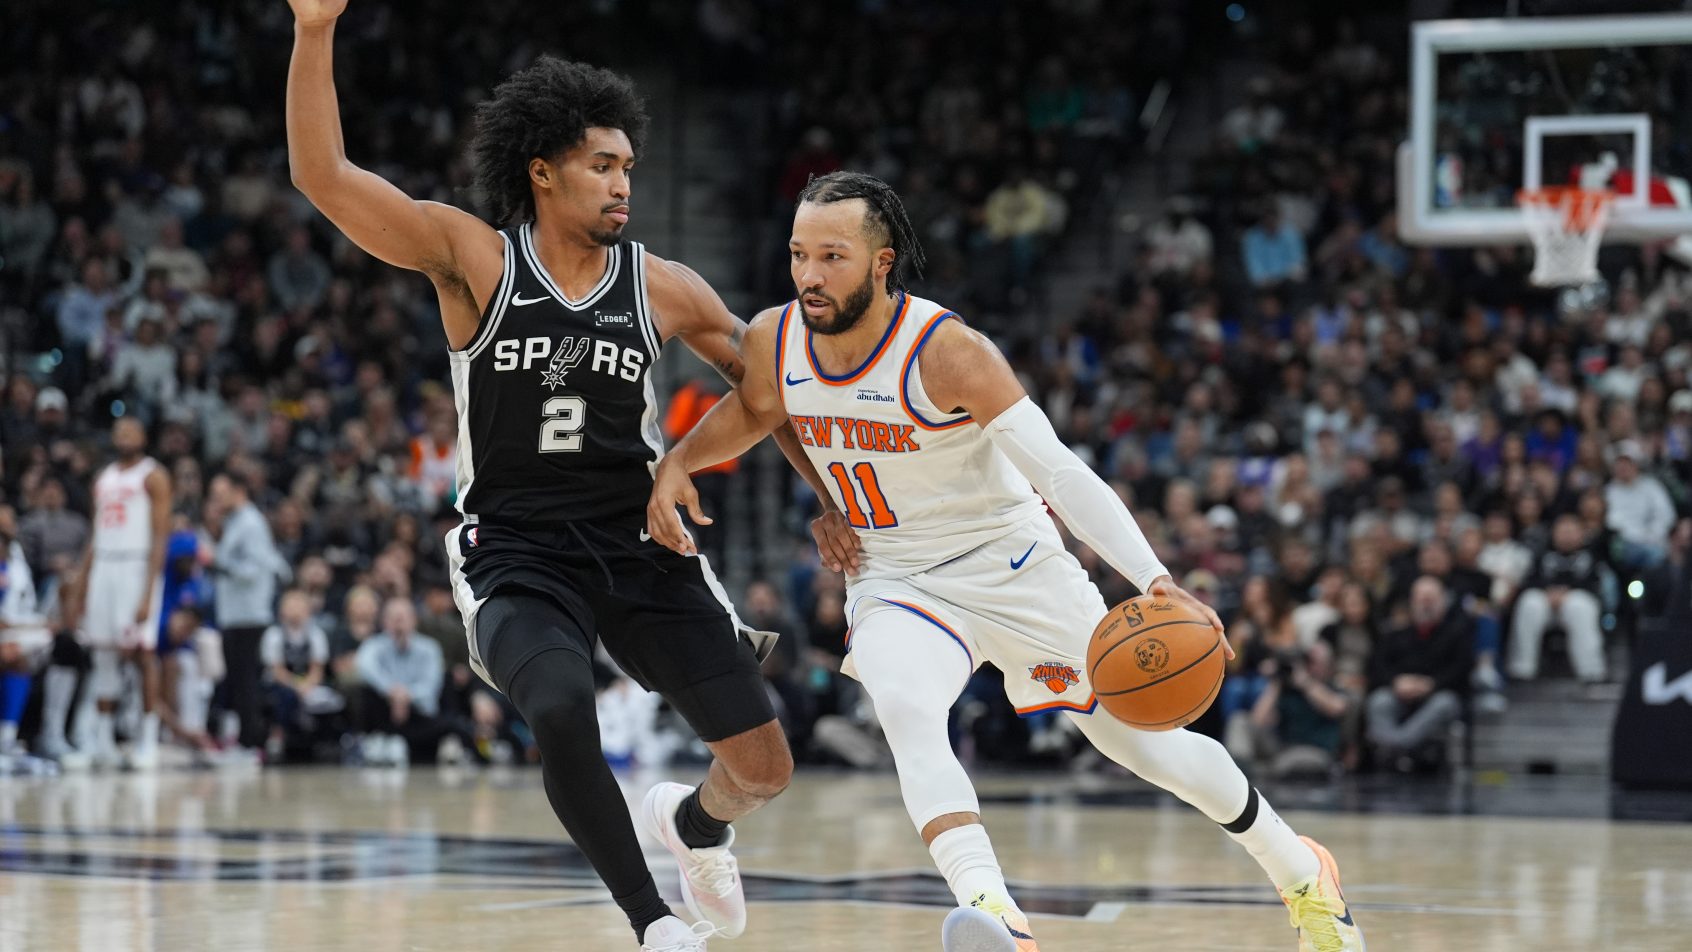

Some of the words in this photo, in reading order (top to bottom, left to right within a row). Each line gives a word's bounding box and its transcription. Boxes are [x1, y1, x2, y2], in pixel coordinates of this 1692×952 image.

[599, 315, 629, 323] LEDGER
[494, 336, 645, 390] SPURS
[856, 393, 872, 401] abu
[872, 394, 895, 403] dhabi
[538, 396, 587, 453] 2
[834, 416, 921, 453] YORK
[827, 461, 899, 530] 11
[1030, 664, 1081, 684] KNICKS
